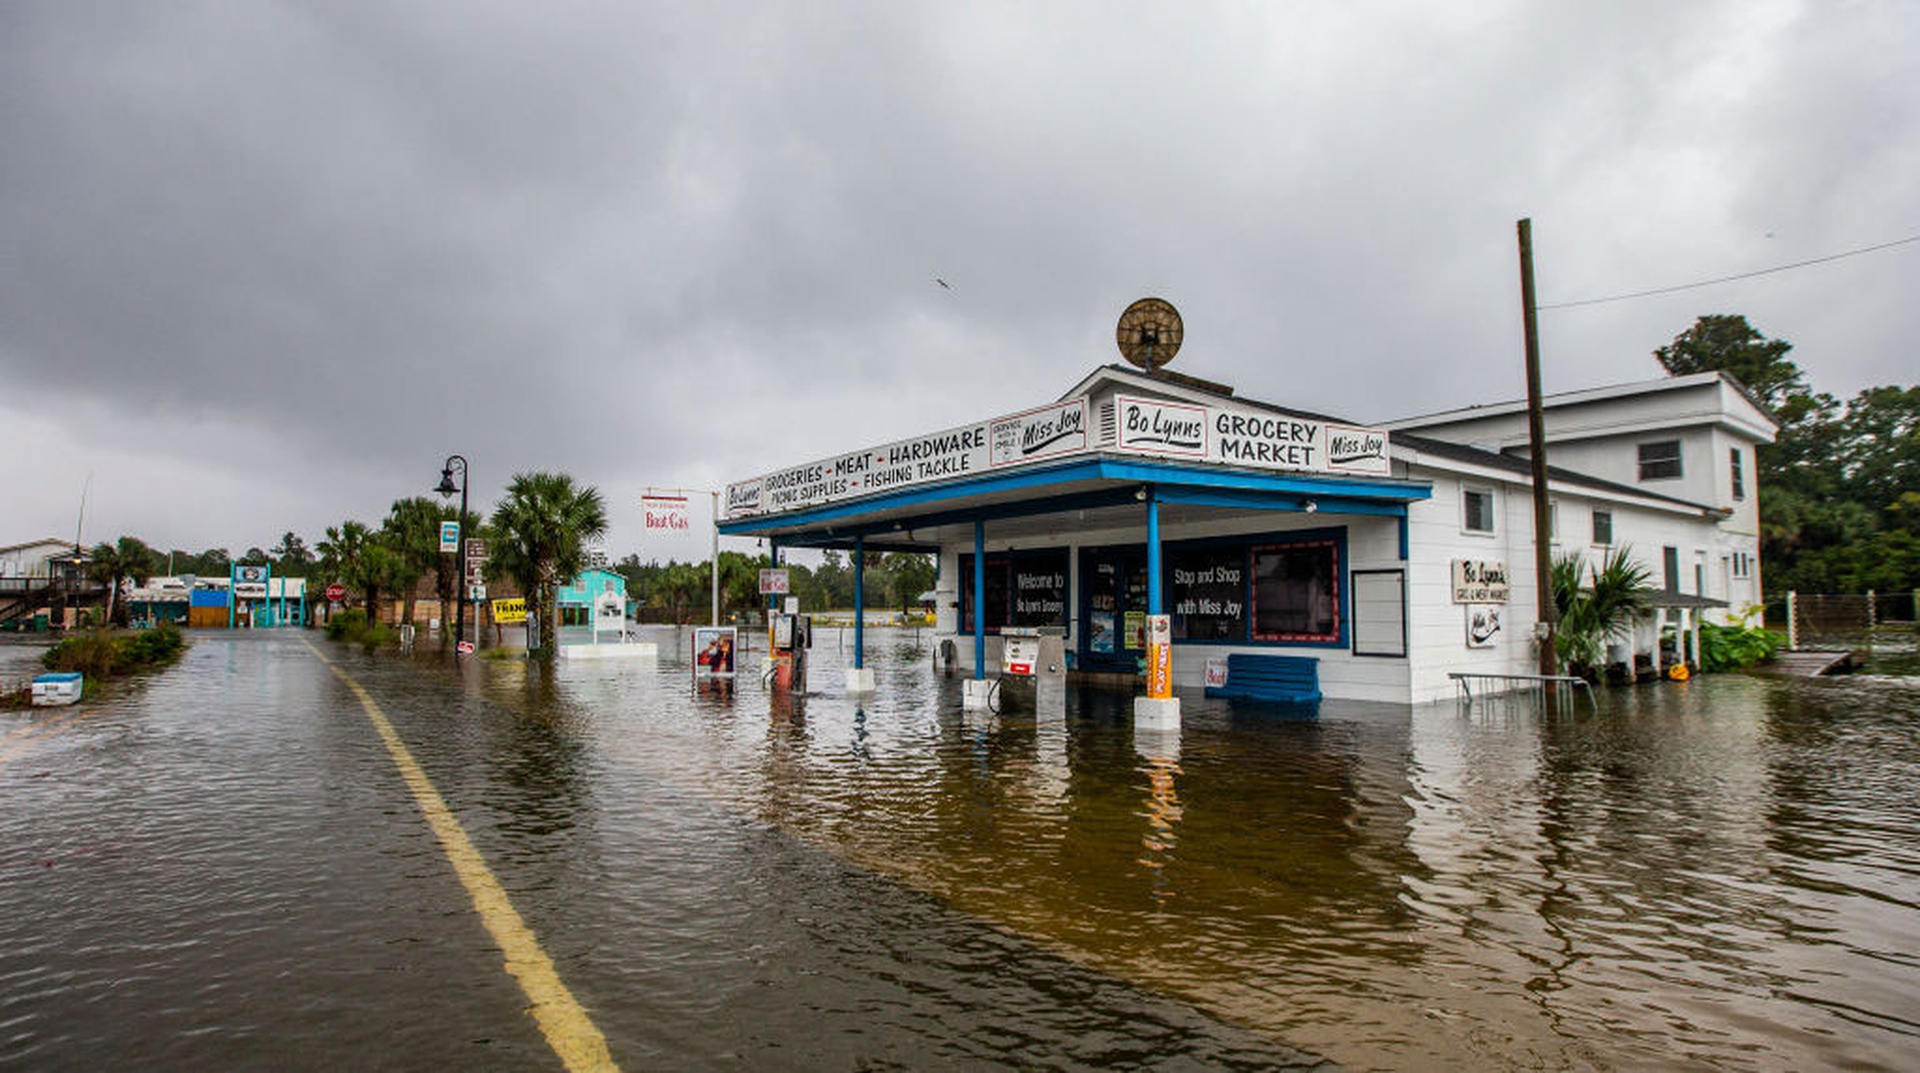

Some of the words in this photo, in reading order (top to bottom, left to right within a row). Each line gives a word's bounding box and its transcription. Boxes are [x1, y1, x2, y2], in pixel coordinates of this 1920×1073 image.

[1022, 421, 1053, 448] Miss
[1055, 409, 1083, 433] Joy
[1127, 405, 1148, 431] Bo
[1152, 408, 1201, 441] Lynns
[1216, 414, 1317, 443] GROCERY
[765, 465, 822, 491] GROCERIES
[835, 453, 873, 477] MEAT
[889, 426, 985, 465] HARDWARE
[1221, 439, 1315, 465] MARKET
[1331, 436, 1358, 455] Miss
[1361, 434, 1383, 458] Joy
[800, 479, 847, 499] SUPPLIES
[863, 467, 913, 490] FISHING
[919, 454, 970, 480] TACKLE
[646, 511, 668, 528] Boat
[669, 512, 689, 530] Gas
[1017, 573, 1052, 589] Welcome
[1054, 572, 1064, 589] to
[1175, 569, 1195, 588] Stop
[1198, 566, 1214, 583] and
[1216, 566, 1240, 586] Shop
[1463, 560, 1476, 584] Bo
[1176, 598, 1197, 614] with
[1199, 598, 1221, 614] Miss
[1223, 600, 1242, 620] Joy
[1155, 668, 1167, 693] PLAY
